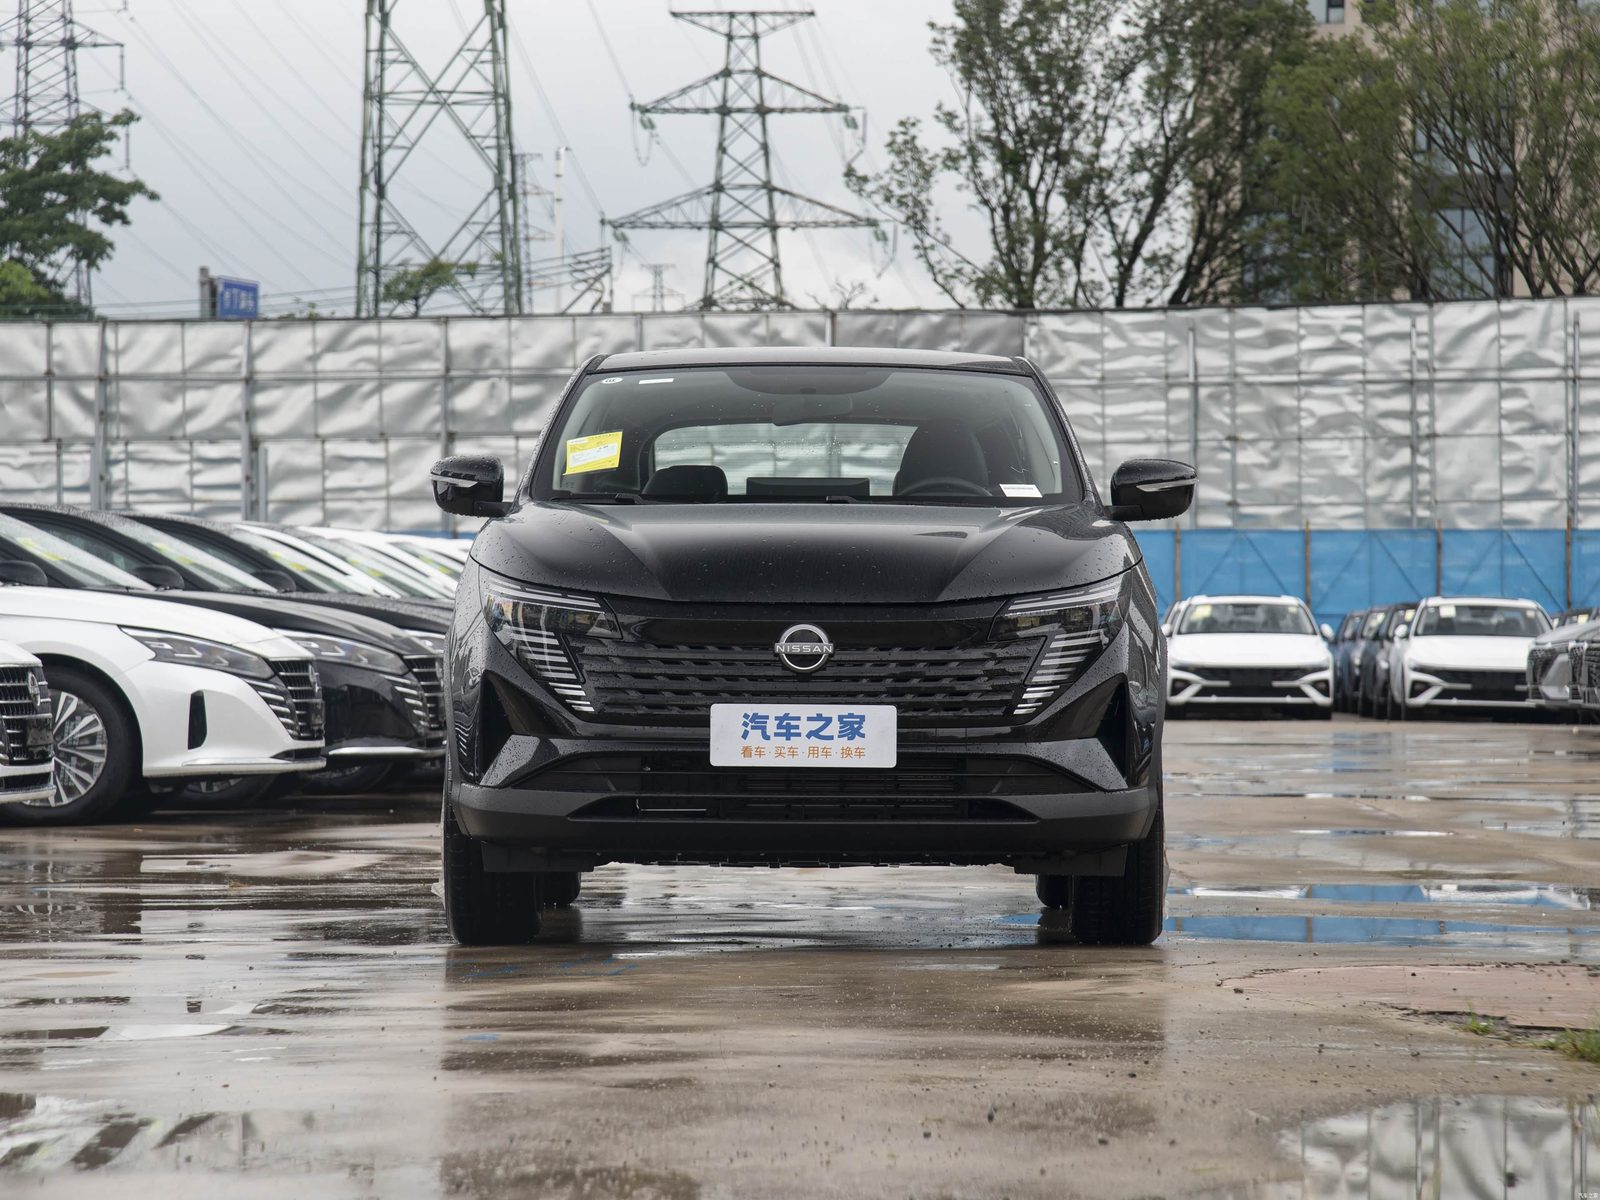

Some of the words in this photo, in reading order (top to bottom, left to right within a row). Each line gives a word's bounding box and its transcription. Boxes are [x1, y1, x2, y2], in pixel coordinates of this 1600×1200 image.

[776, 645, 832, 653] NISSAN
[741, 712, 866, 741] 汽车之家
